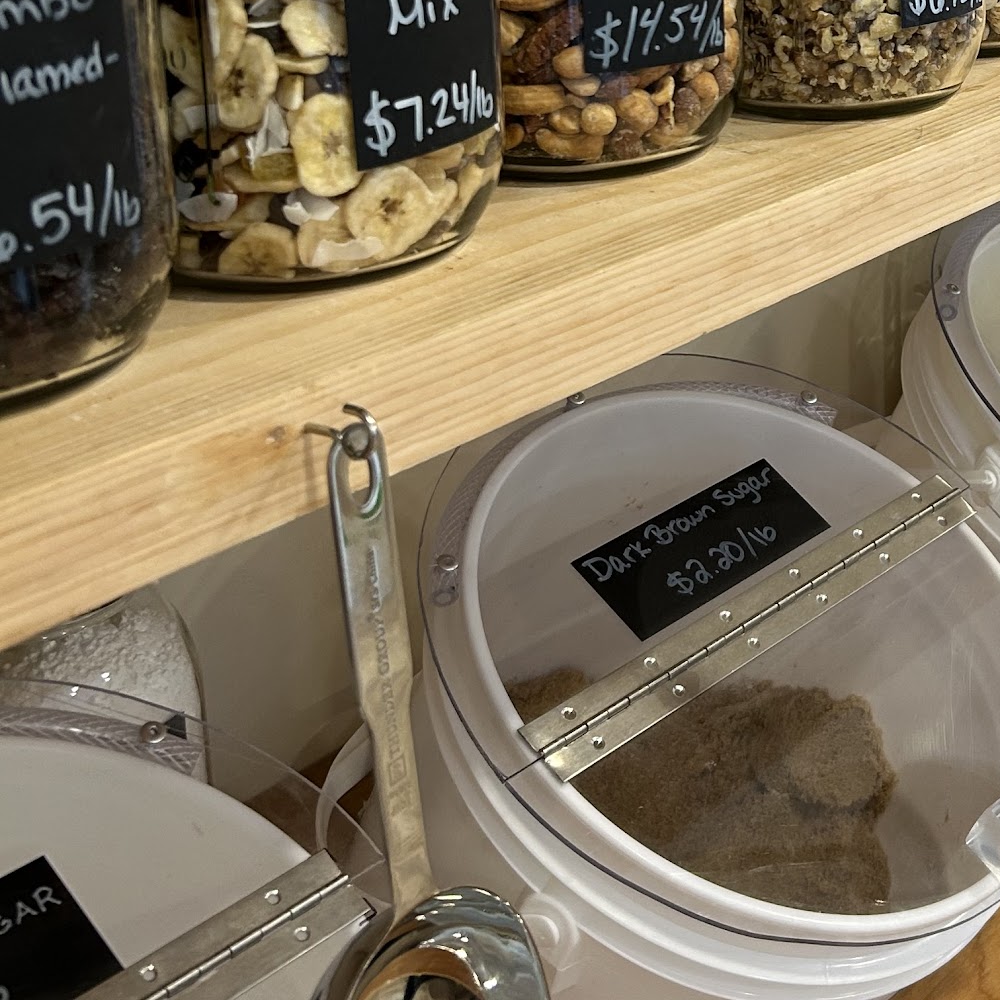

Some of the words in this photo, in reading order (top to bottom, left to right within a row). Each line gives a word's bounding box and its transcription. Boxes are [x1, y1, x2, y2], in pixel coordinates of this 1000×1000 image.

[364, 69, 494, 157] $7.24/lb
[581, 540, 652, 582] Dark
[643, 504, 716, 546] Brown
[711, 466, 771, 506] Sugar
[666, 525, 778, 596] $2.20/lb
